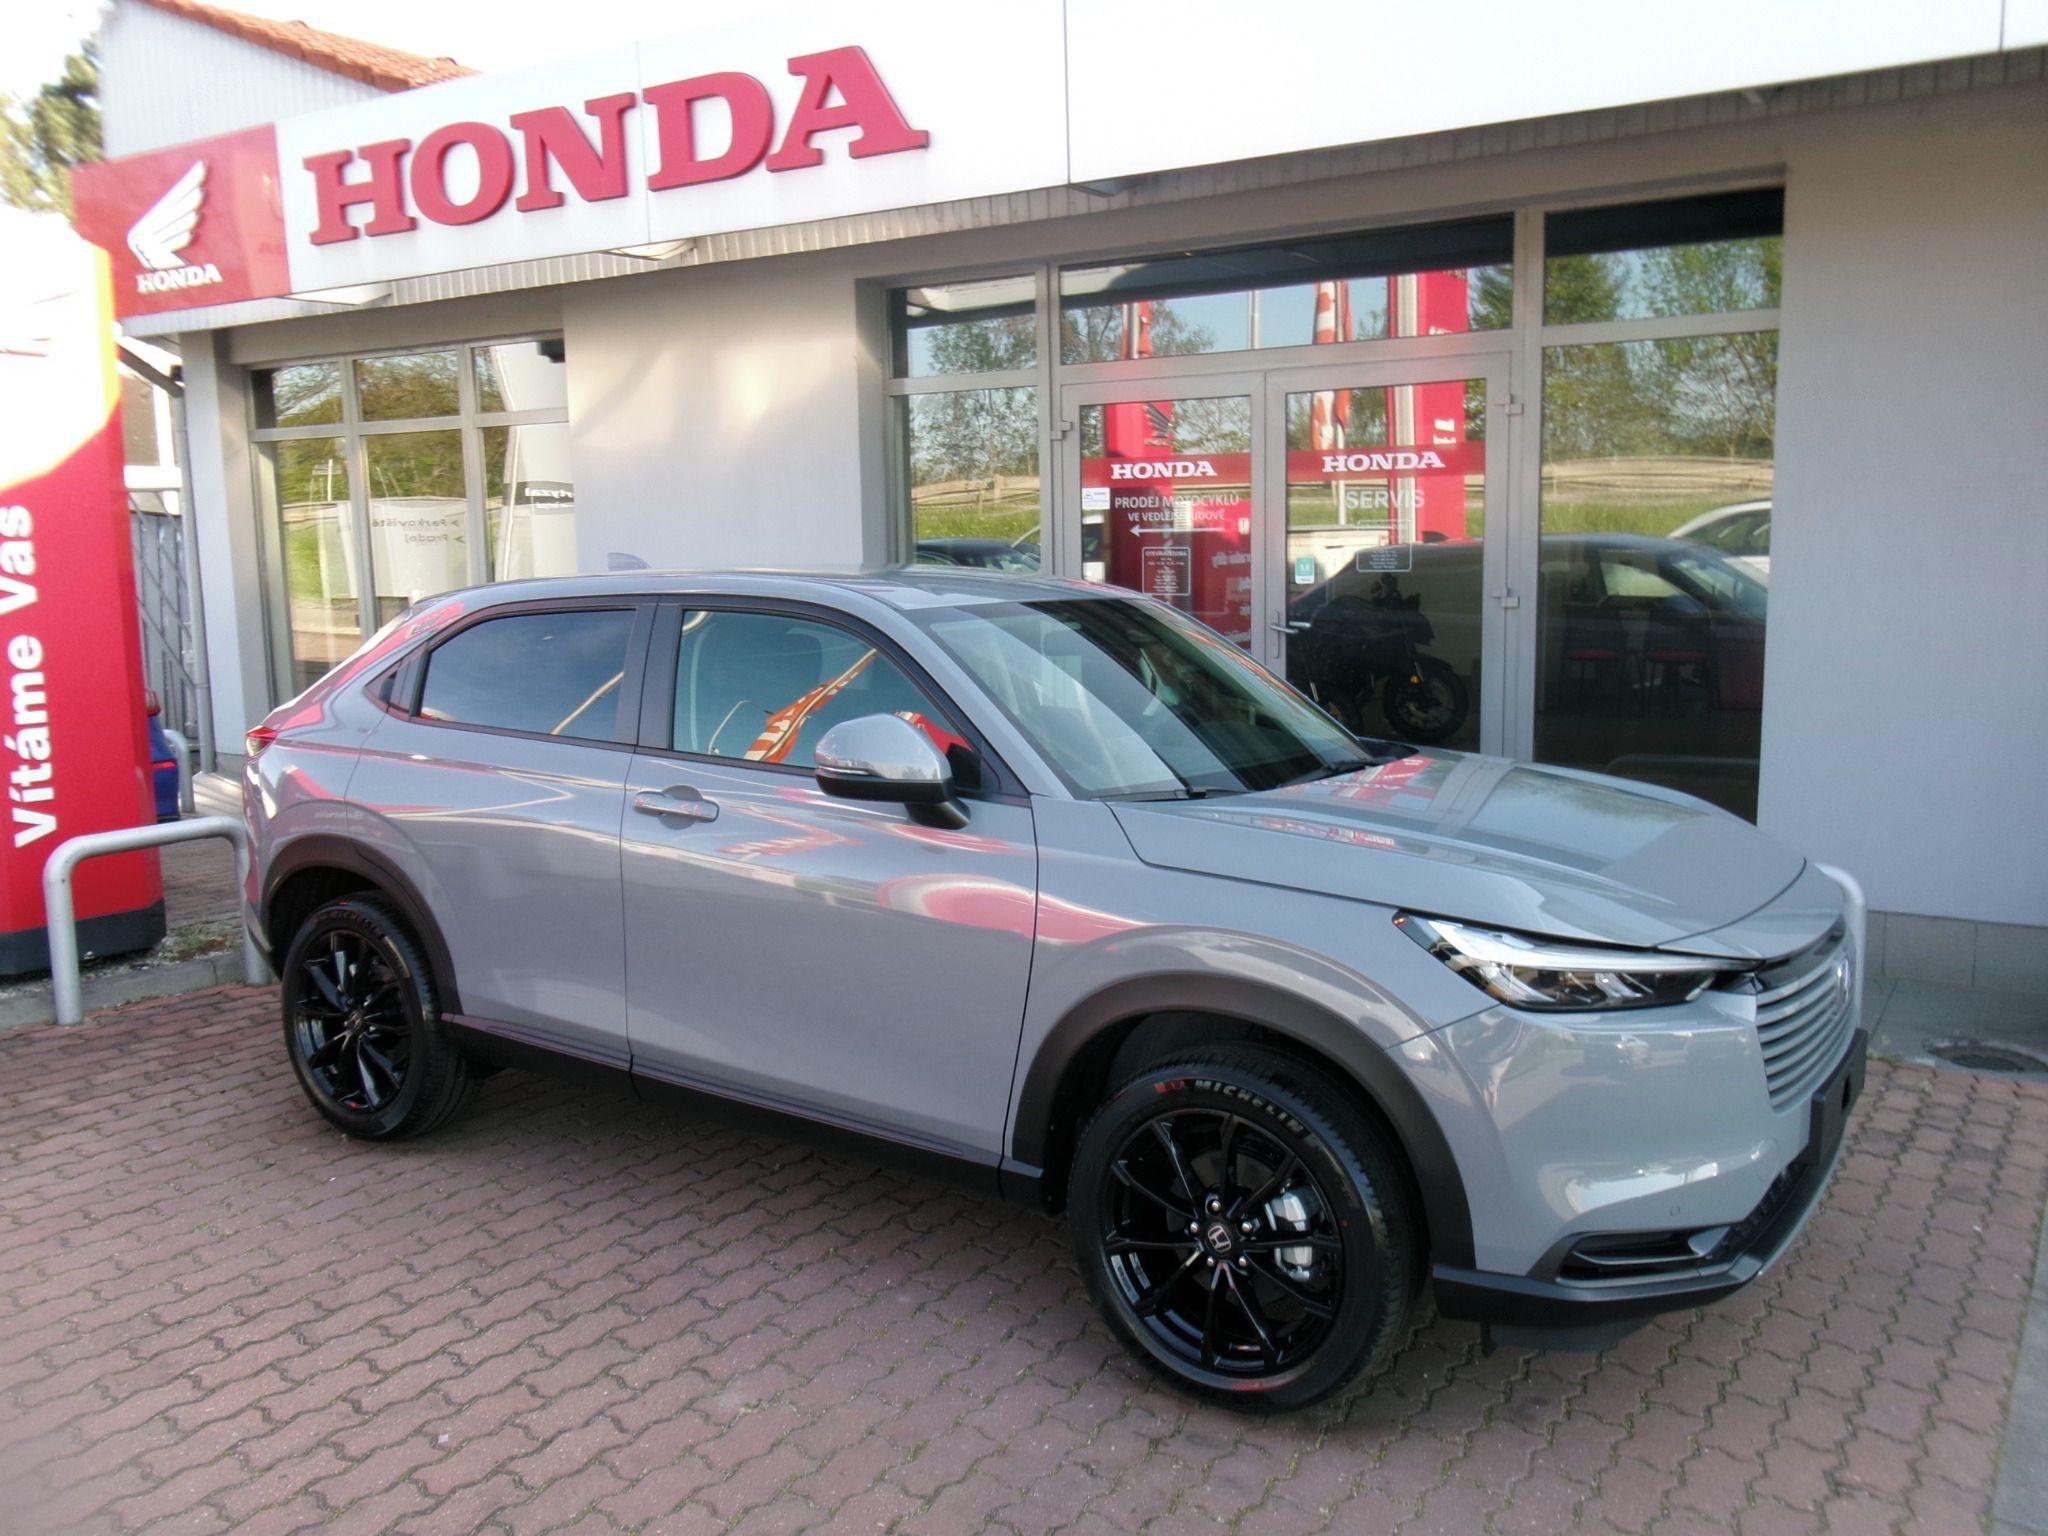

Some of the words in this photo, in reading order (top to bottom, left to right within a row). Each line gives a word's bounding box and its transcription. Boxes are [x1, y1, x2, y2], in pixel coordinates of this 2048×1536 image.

[303, 45, 929, 246] HONDA
[136, 263, 223, 294] HONDA
[1111, 461, 1217, 479] HONDA
[1322, 451, 1445, 472] HONDA
[1114, 496, 1159, 509] PRODEJ
[1162, 491, 1239, 508] MOTOCYKLŮ
[1346, 489, 1424, 509] SERVIS
[1128, 512, 1140, 522] VE
[1187, 508, 1225, 521] UDOVĚ
[4, 634, 58, 849] Vítáme
[1194, 1079, 1305, 1133] MICHELIN
